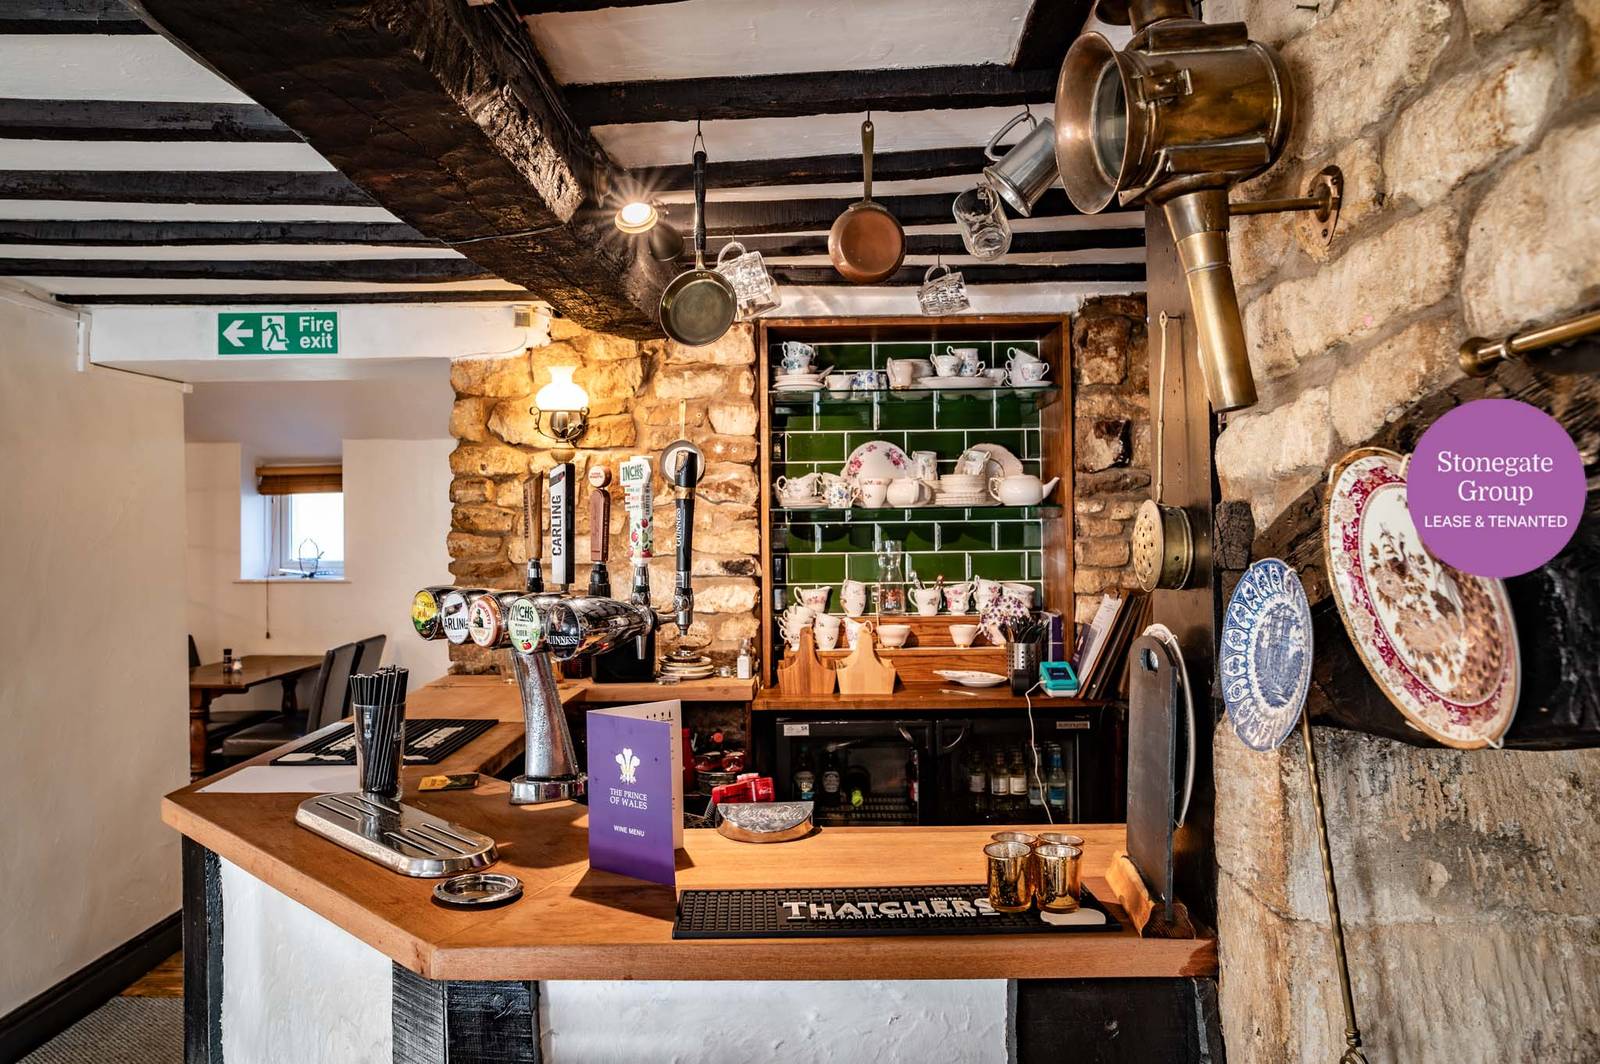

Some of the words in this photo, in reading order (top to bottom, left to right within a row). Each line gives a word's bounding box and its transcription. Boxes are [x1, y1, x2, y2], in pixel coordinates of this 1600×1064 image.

[299, 316, 334, 332] Fire
[299, 333, 333, 349] exit
[551, 495, 562, 556] CARLING
[610, 787, 622, 796] THE
[624, 790, 648, 801] PRINCE
[610, 796, 620, 805] OF
[622, 797, 648, 810] WALES
[613, 824, 628, 834] WINE
[629, 827, 645, 837] MENU
[783, 898, 997, 919] THATCHERS
